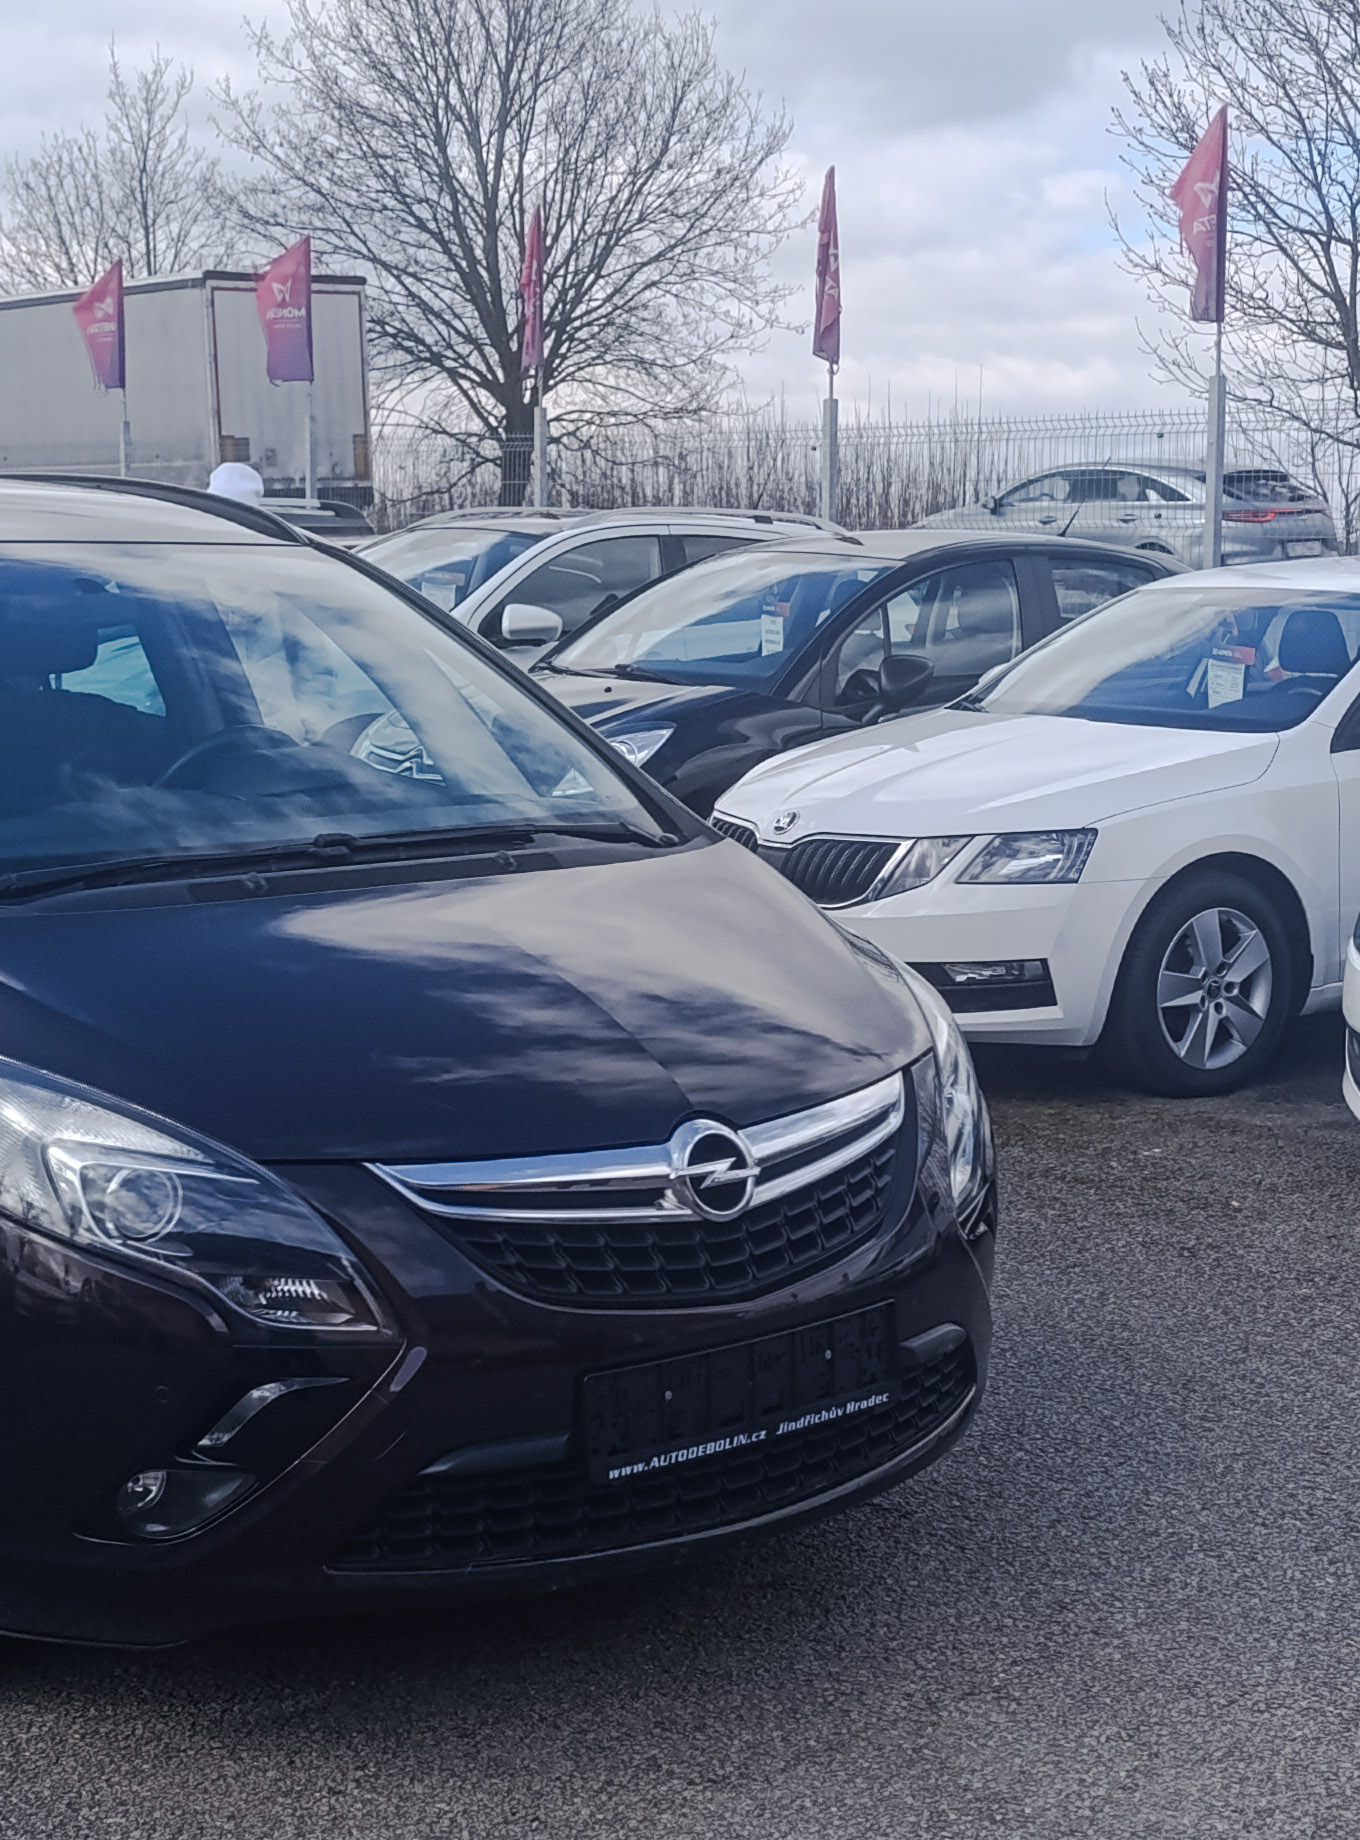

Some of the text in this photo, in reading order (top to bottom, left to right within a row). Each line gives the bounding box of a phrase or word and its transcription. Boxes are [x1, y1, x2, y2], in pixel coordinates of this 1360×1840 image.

[608, 1391, 890, 1480] www.AUTODEBOLIN.cz Jindřichův Hradec
